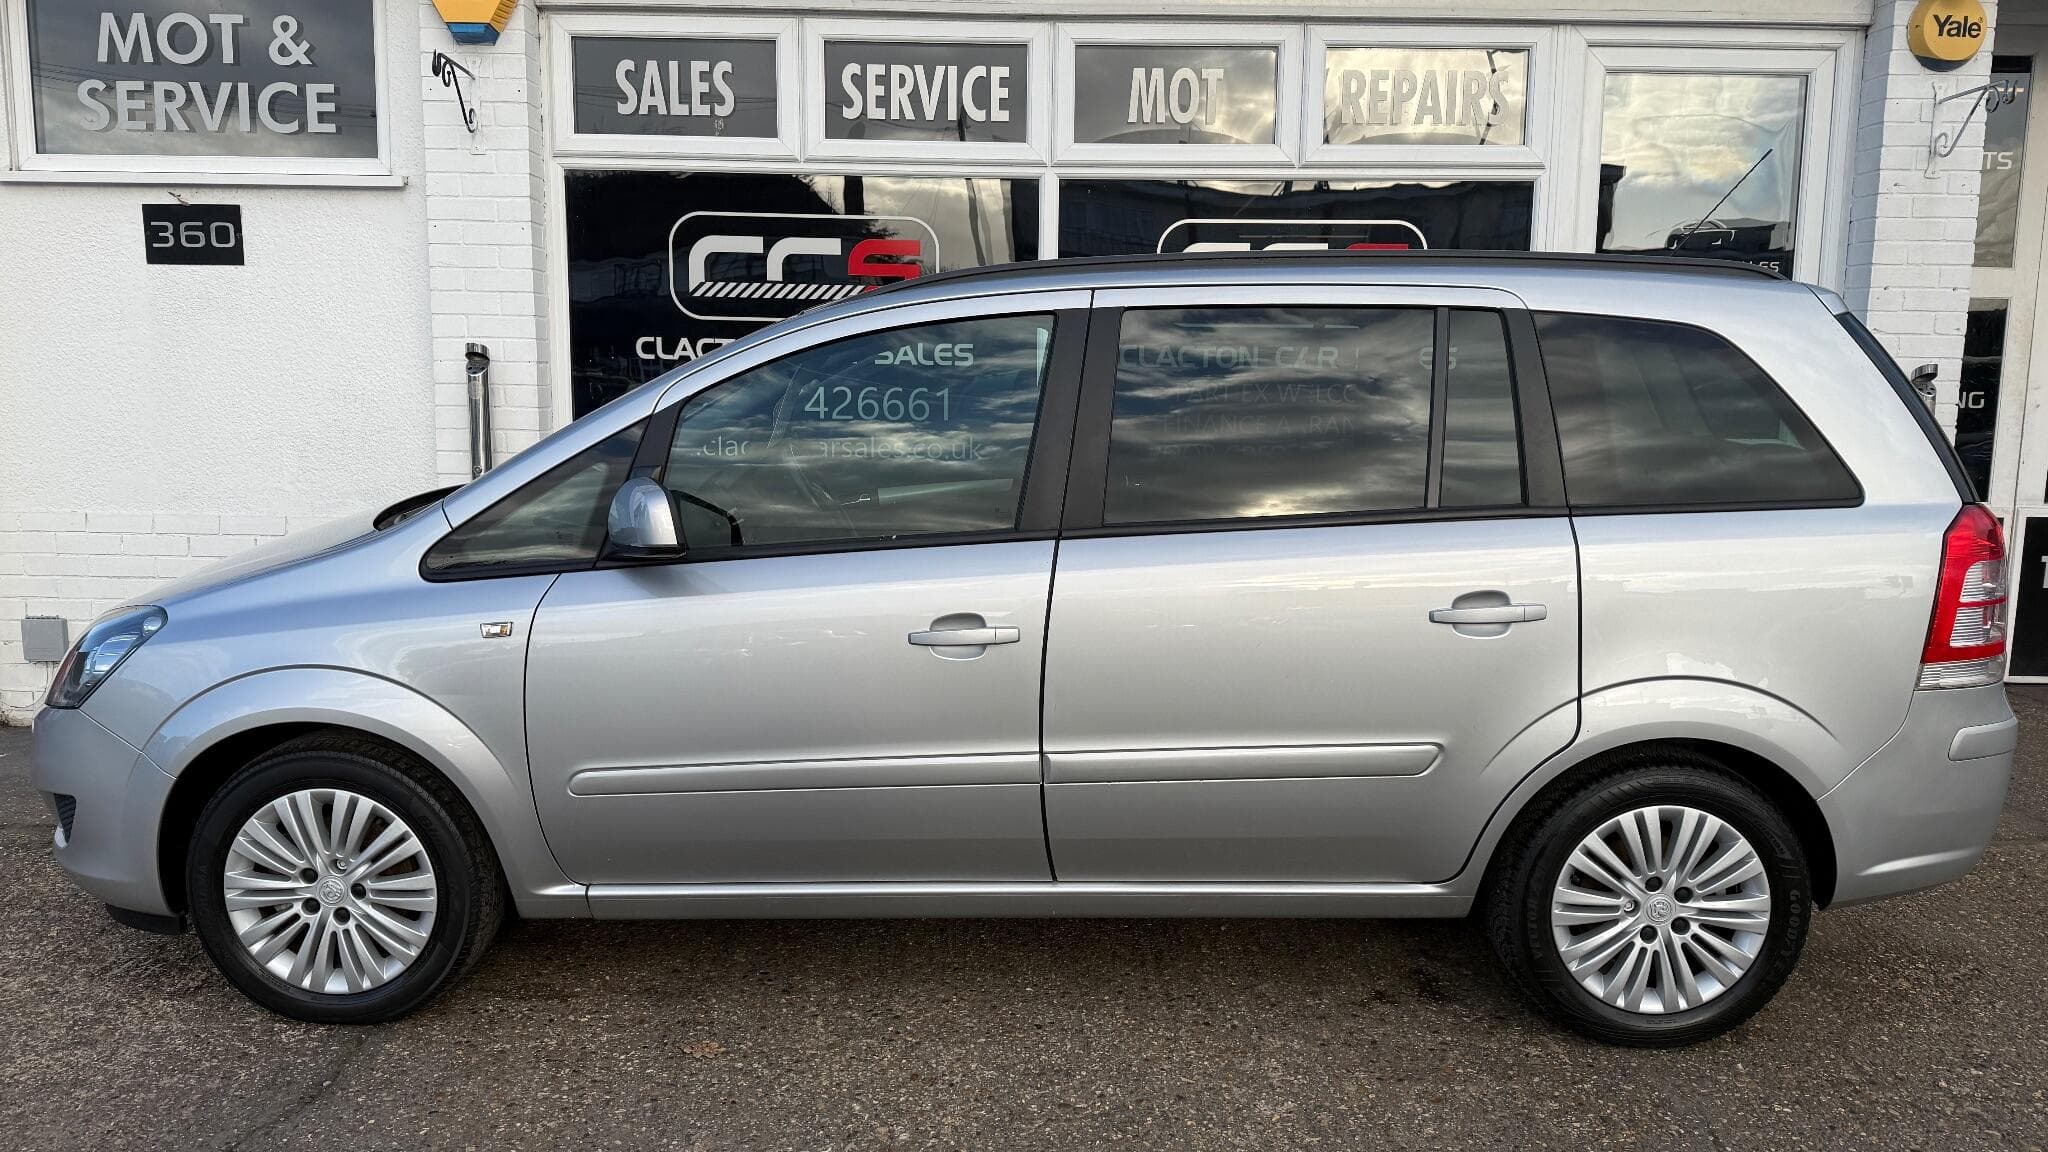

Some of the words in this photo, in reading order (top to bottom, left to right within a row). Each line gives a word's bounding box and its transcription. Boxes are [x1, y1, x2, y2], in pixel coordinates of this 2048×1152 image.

[98, 12, 244, 64] MOT
[268, 15, 312, 66] &
[1932, 14, 1983, 38] Yale
[77, 79, 337, 134] SERVICE
[615, 59, 735, 118] SALES
[842, 62, 1010, 122] SERVICE
[1127, 66, 1224, 125] MOT
[1340, 69, 1509, 125] REPAIRS
[151, 221, 236, 249] 360
[1119, 345, 1258, 368] CLACTON
[804, 386, 949, 421] 426661
